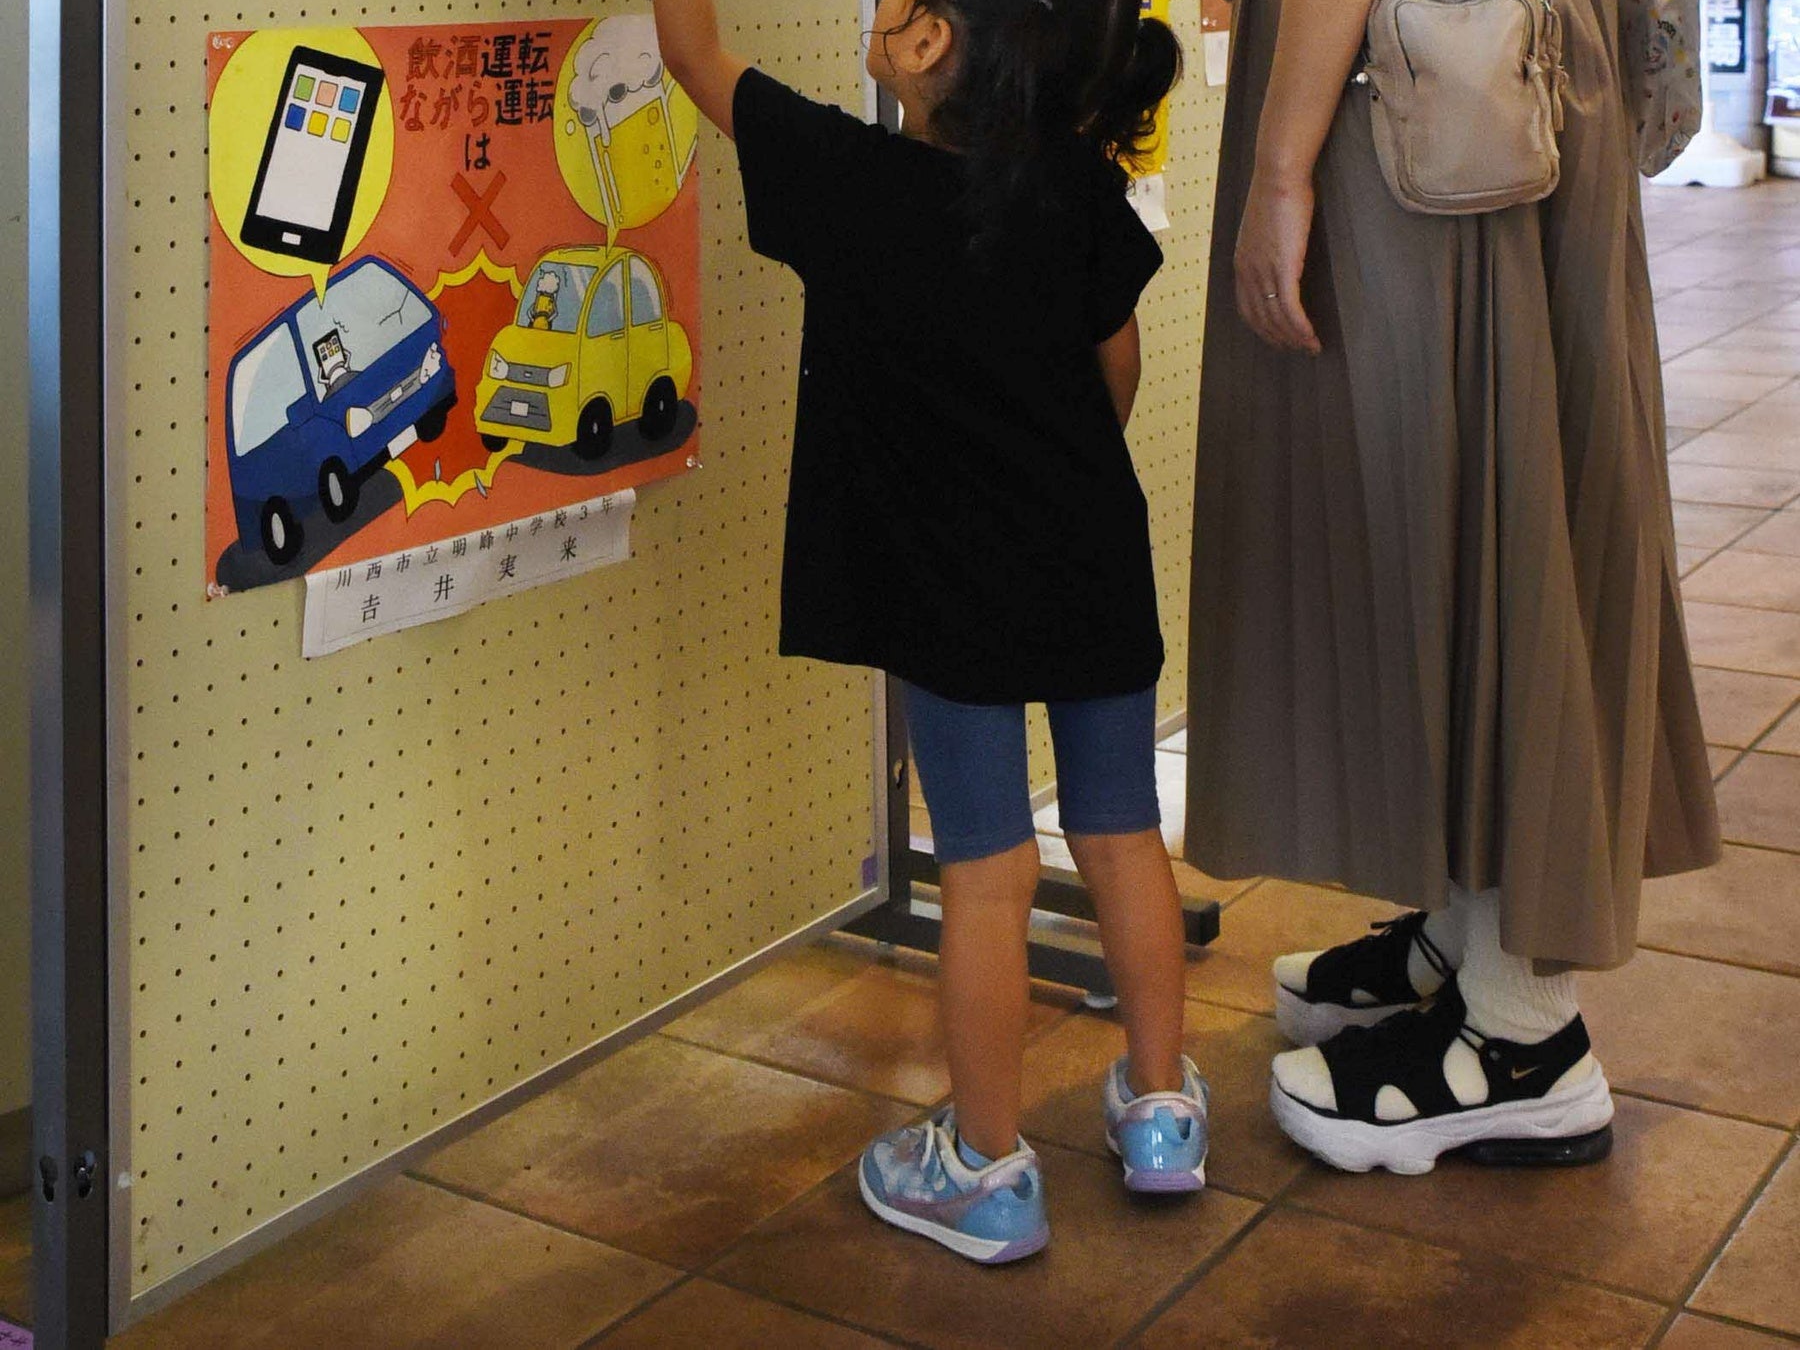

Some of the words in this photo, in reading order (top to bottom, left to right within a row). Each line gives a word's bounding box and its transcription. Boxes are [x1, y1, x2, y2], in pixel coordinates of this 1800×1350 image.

[405, 31, 553, 81] 飲酒運転
[399, 78, 554, 132] ながら運転
[464, 132, 492, 172] は
[335, 496, 617, 591] 川西市立明峰中学校3年
